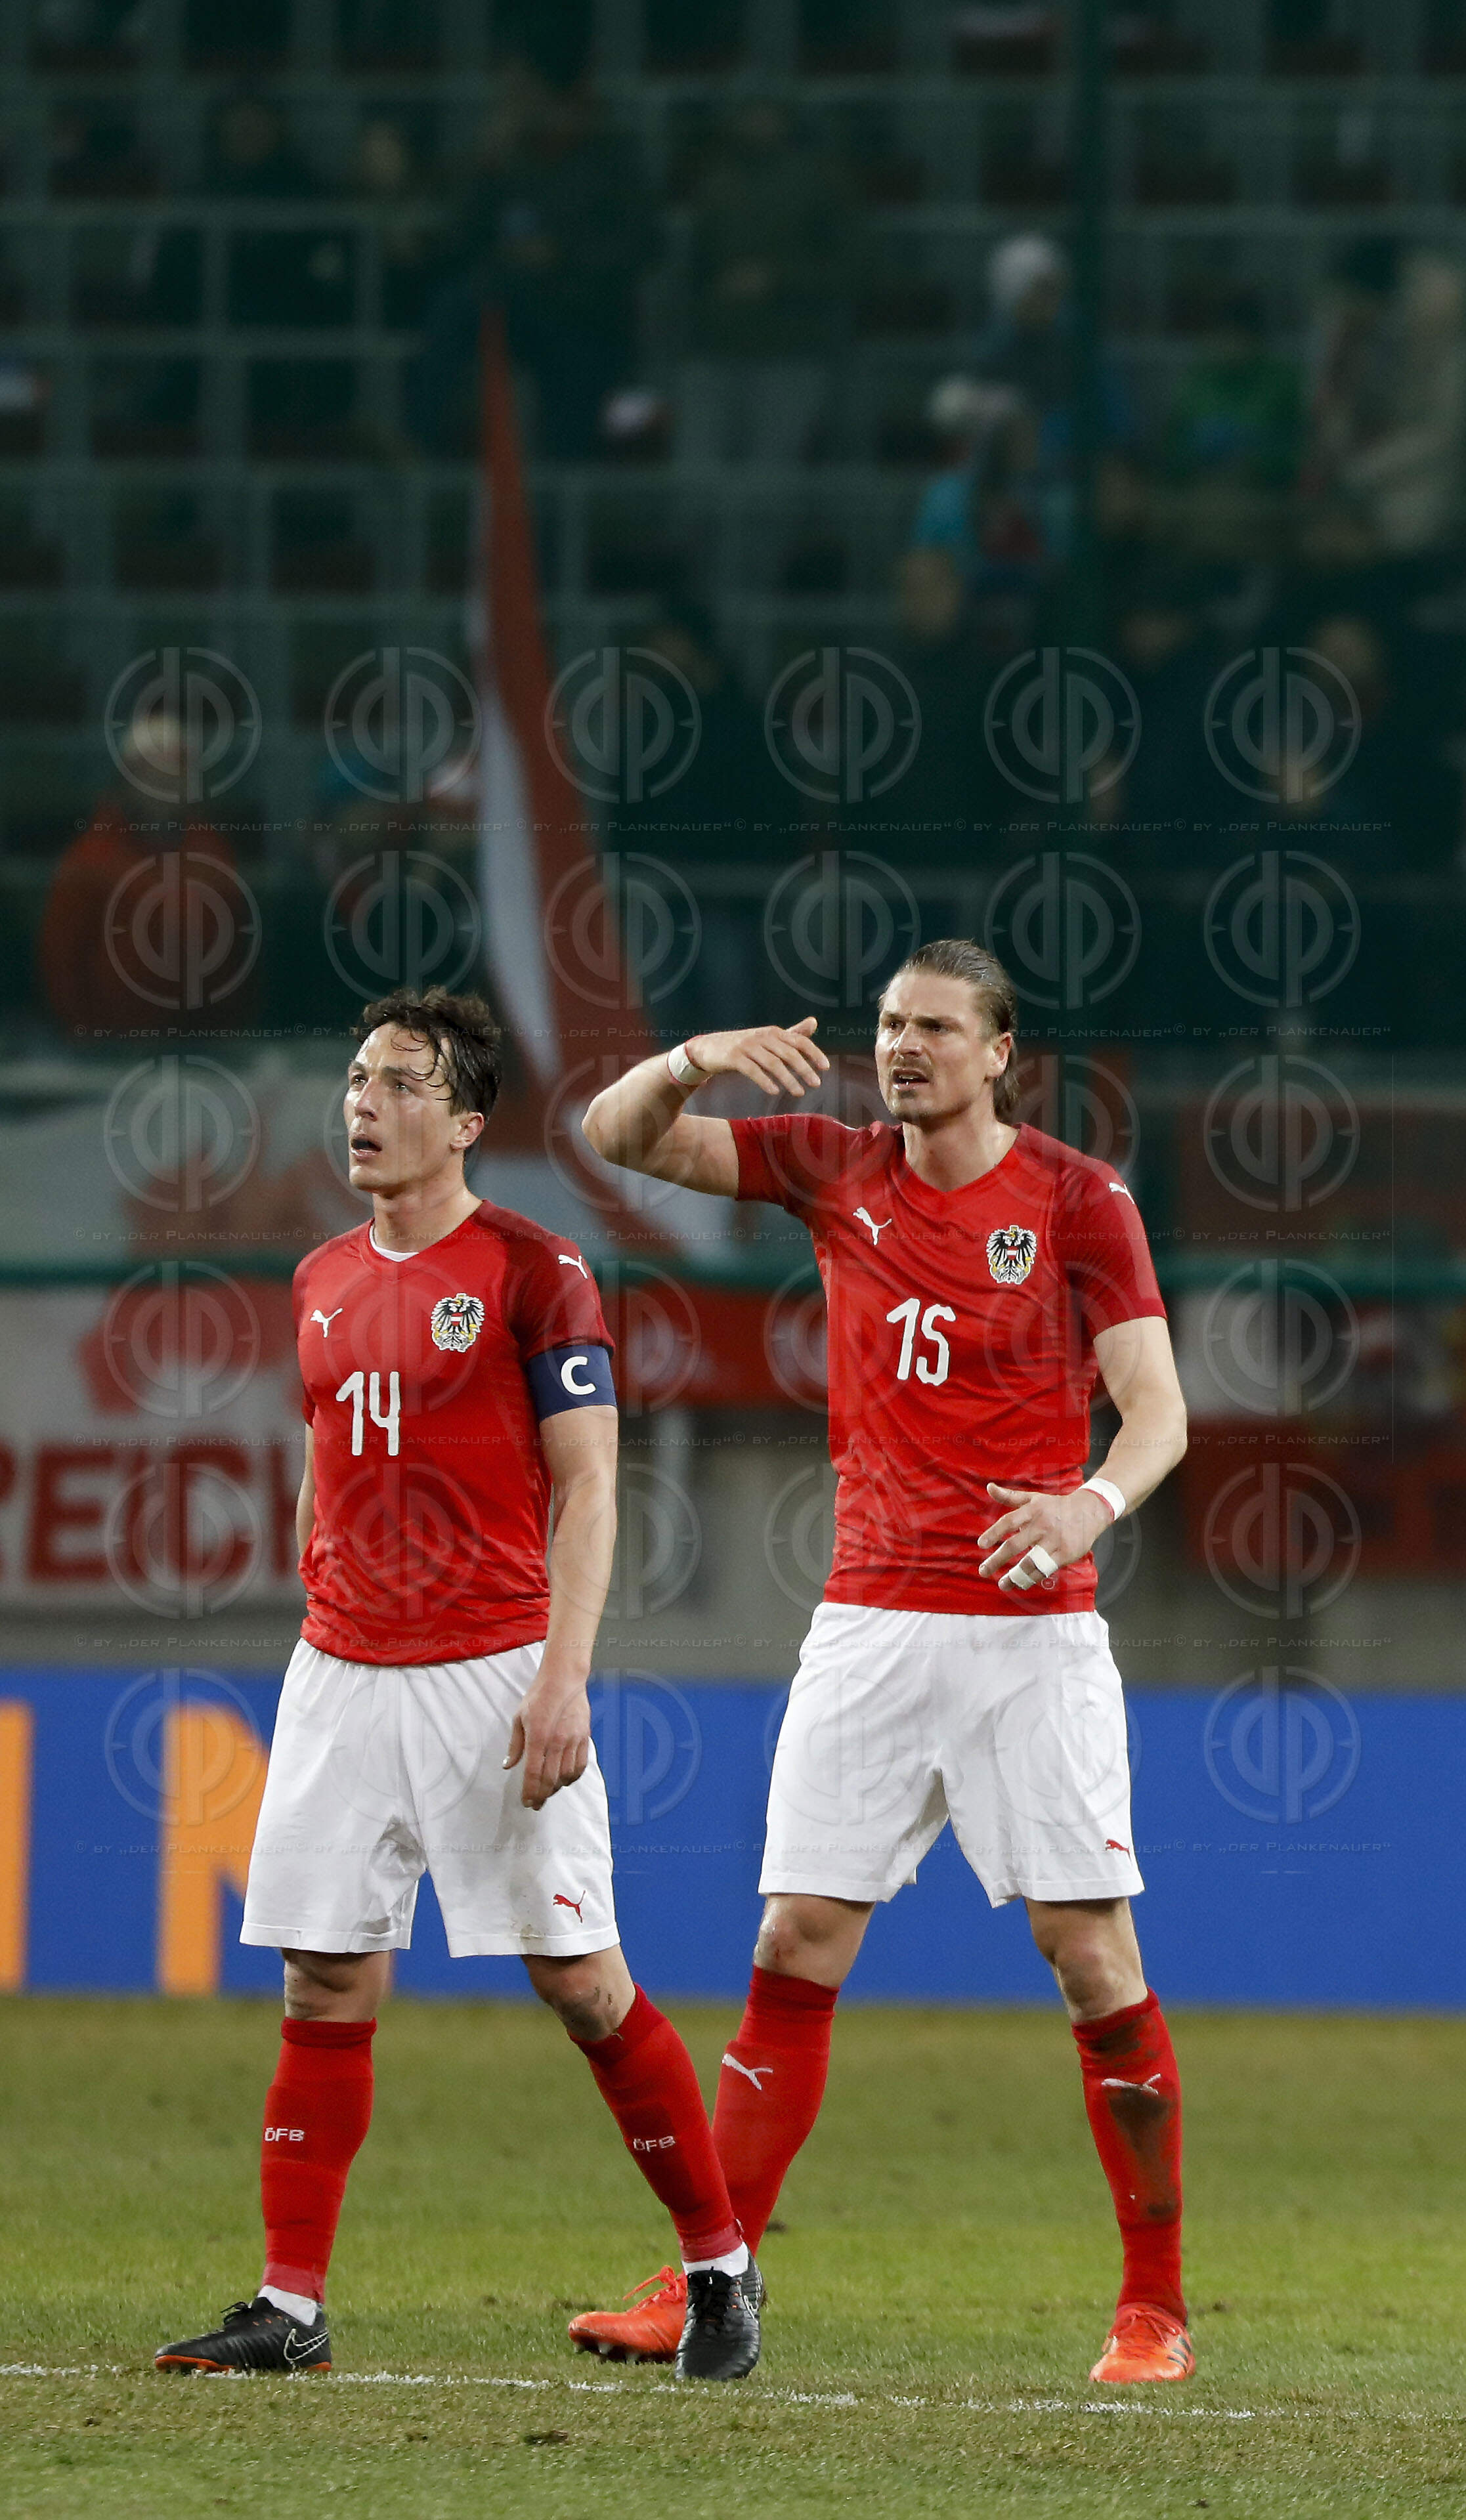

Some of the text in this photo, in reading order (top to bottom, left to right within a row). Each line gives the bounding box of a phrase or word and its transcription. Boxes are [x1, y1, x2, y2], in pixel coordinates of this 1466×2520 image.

[886, 1298, 956, 1386] 15
[561, 1356, 597, 1396] C
[335, 1371, 401, 1457] 14
[265, 2127, 305, 2142] ÖFB
[633, 2135, 676, 2152] ÖFB
